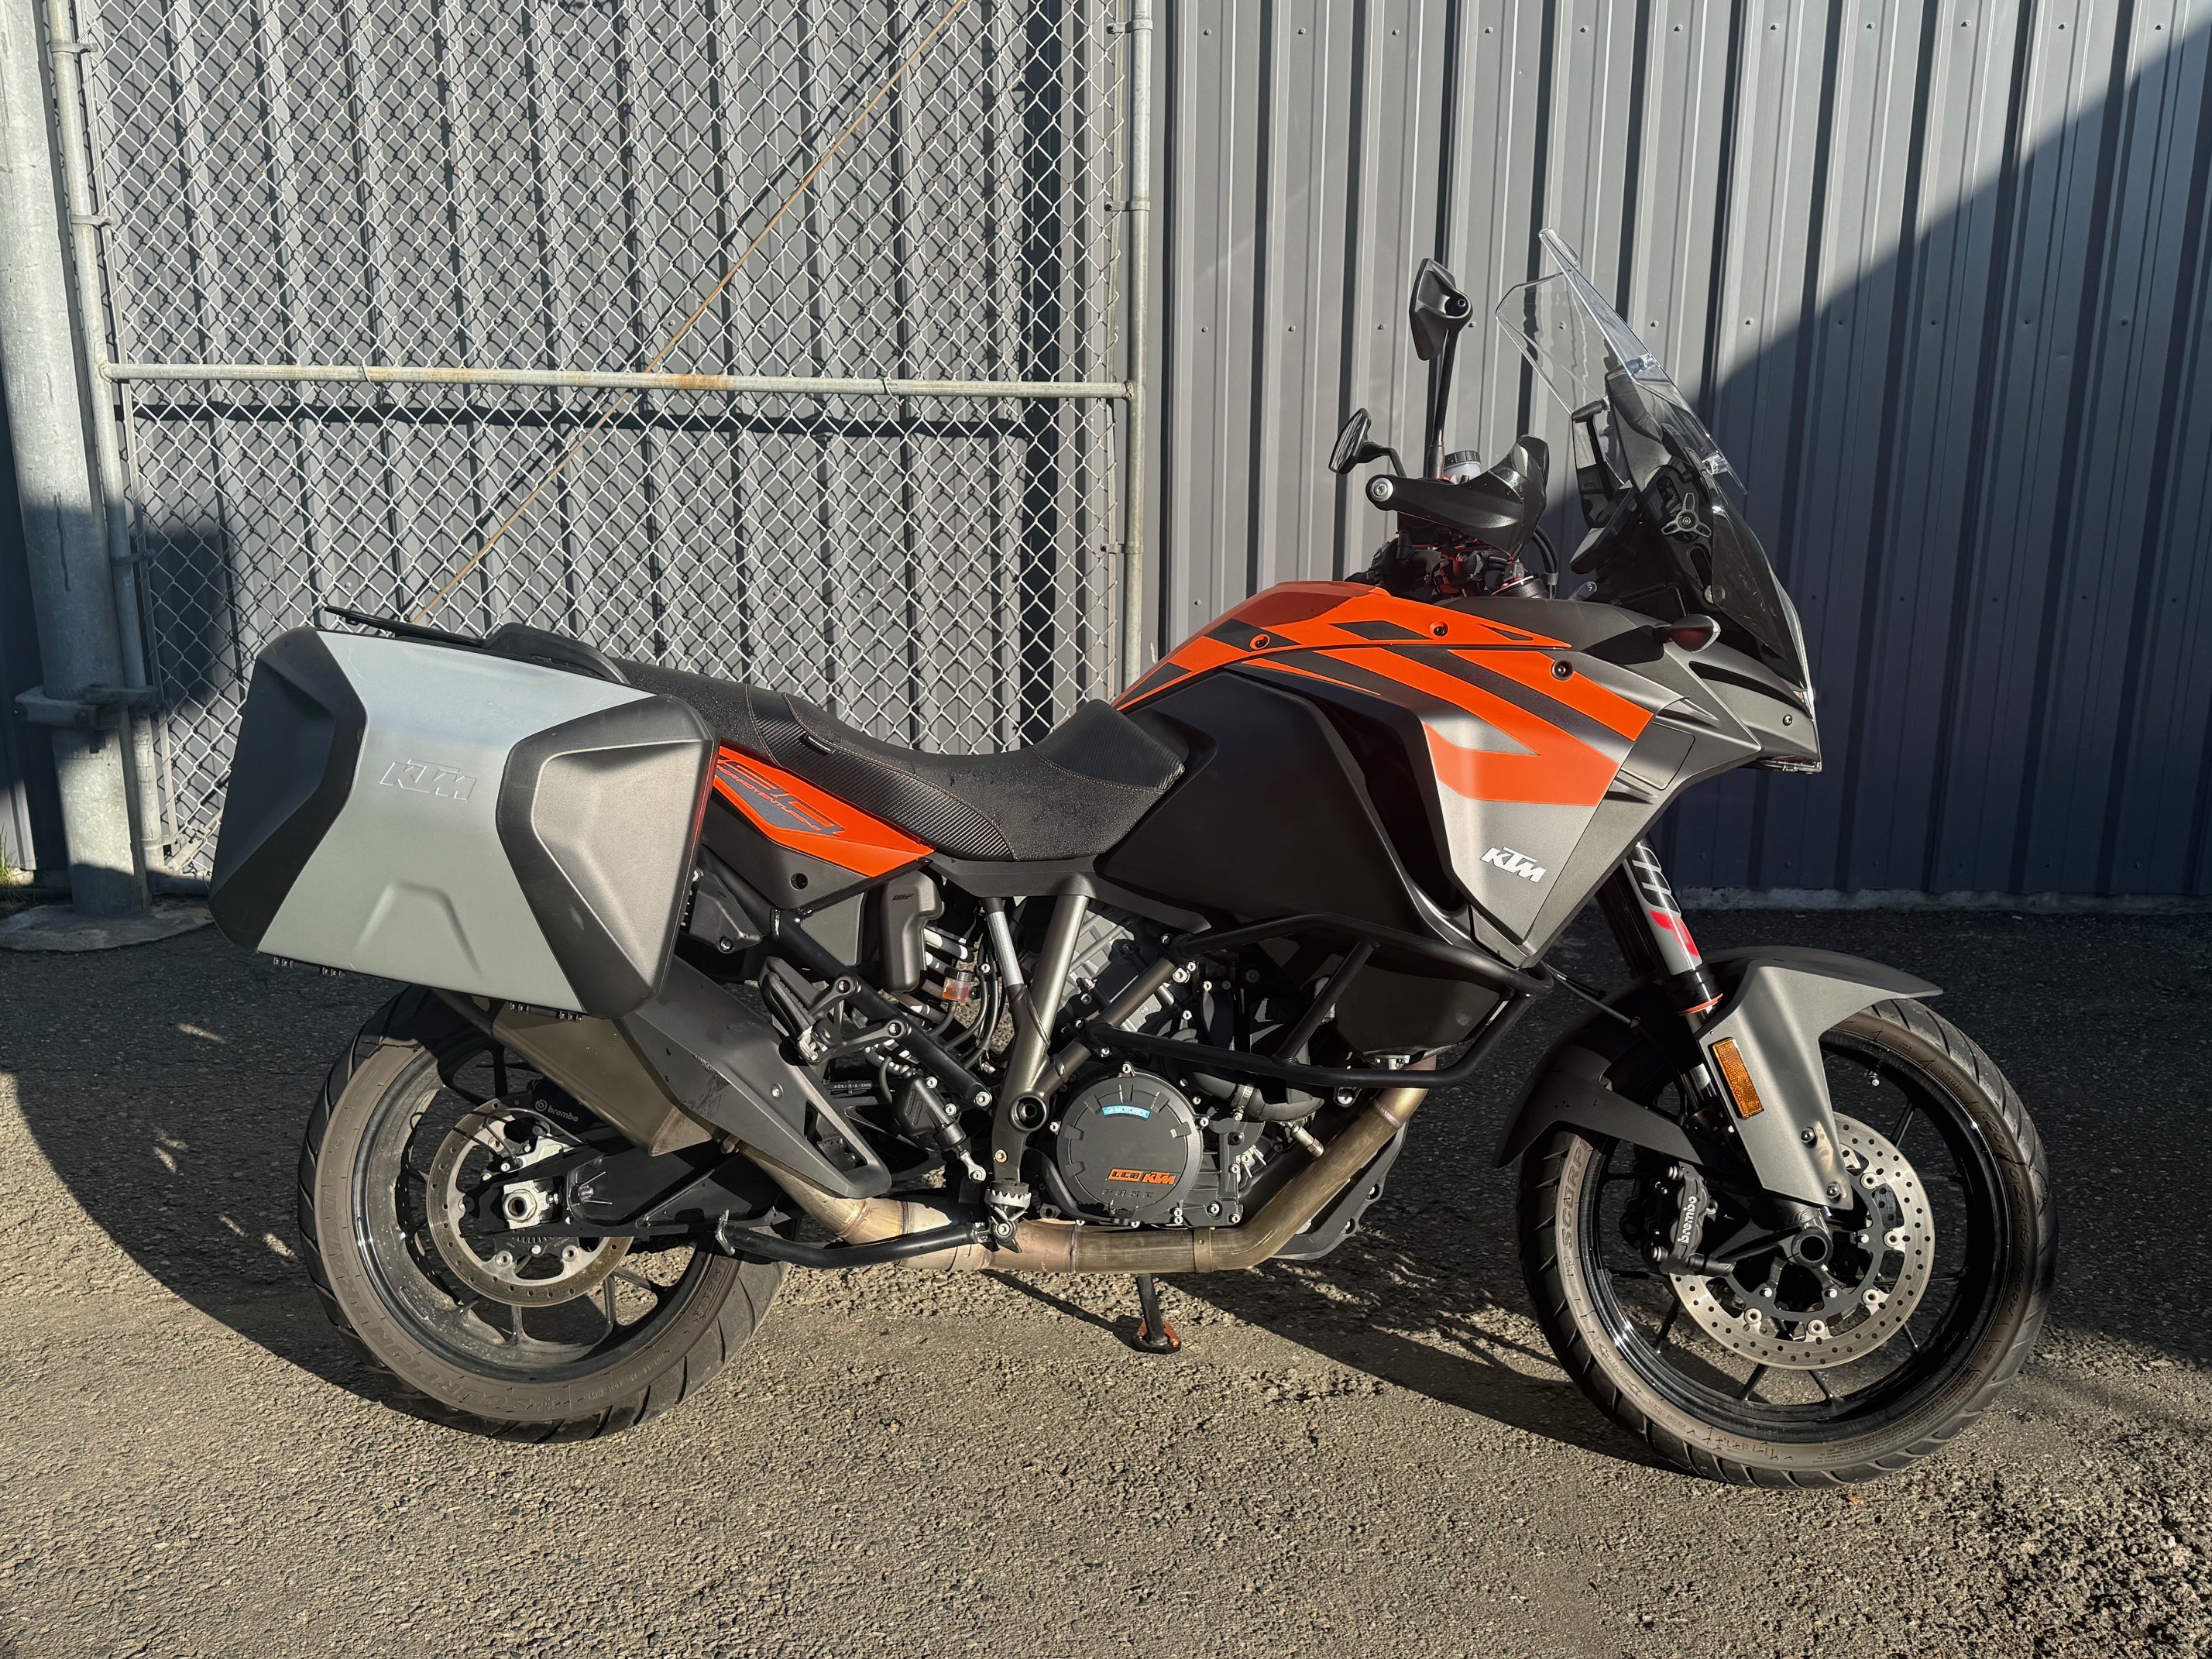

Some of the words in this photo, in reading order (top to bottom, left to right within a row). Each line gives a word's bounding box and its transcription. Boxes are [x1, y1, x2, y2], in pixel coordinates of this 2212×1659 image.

[380, 758, 476, 801] KTM
[1479, 847, 1547, 883] KTM
[548, 1105, 579, 1122] brembo
[1142, 1172, 1176, 1185] KTM
[1561, 1139, 1588, 1249] SCORPI
[1678, 1195, 1697, 1244] brembo
[325, 1222, 369, 1319] TRAIL
[367, 1326, 532, 1410] SCORPION
